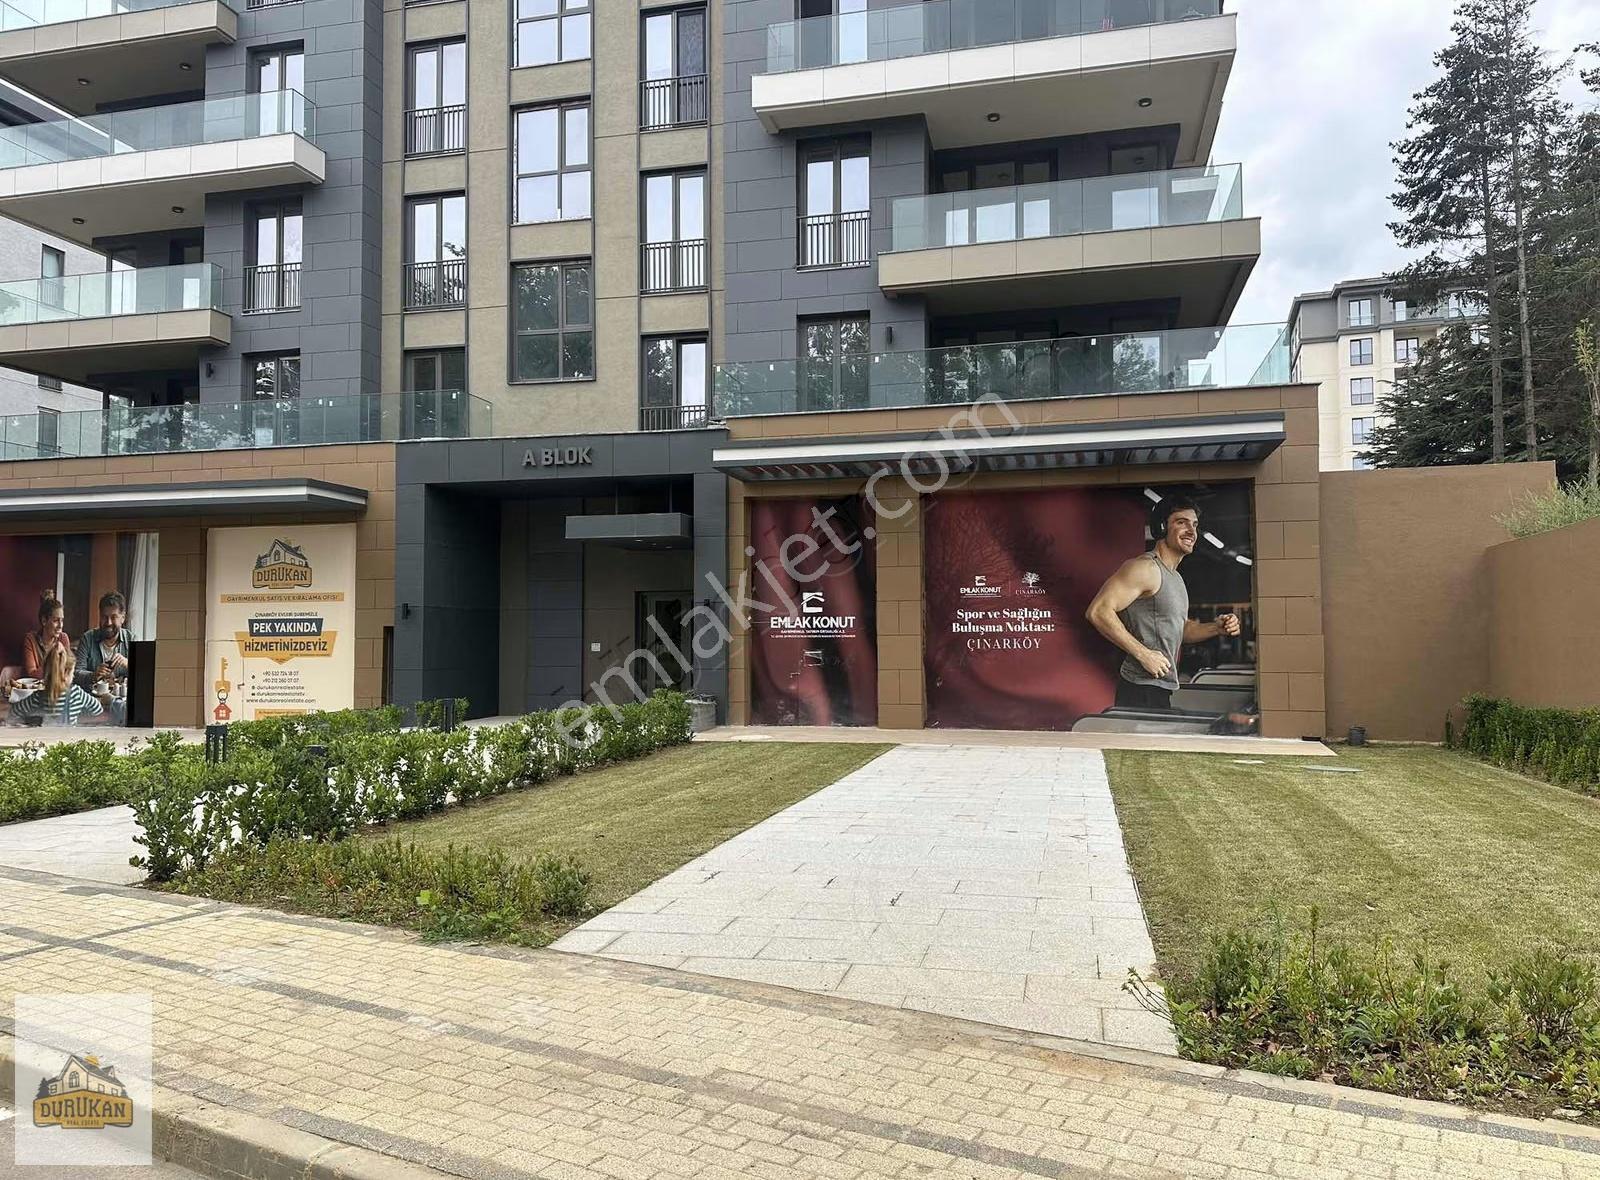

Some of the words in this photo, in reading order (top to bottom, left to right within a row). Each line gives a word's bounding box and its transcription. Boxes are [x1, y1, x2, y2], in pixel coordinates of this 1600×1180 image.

[521, 448, 537, 466] A
[541, 446, 593, 466] BLOK
[257, 567, 308, 581] DURUKAN
[956, 608, 985, 621] Spor
[987, 611, 1000, 619] ve
[1002, 607, 1051, 621] Sağlığın
[253, 622, 272, 633] PEK
[274, 622, 317, 633] YAKINDA
[770, 616, 811, 629] EMLAK
[812, 616, 856, 628] KONUT
[952, 622, 1003, 635] Buluşma
[1005, 621, 1055, 632] Noktası:
[244, 638, 328, 651] HİZMETİNİZDEYİZ
[967, 637, 1041, 651] ÇINARKÖY
